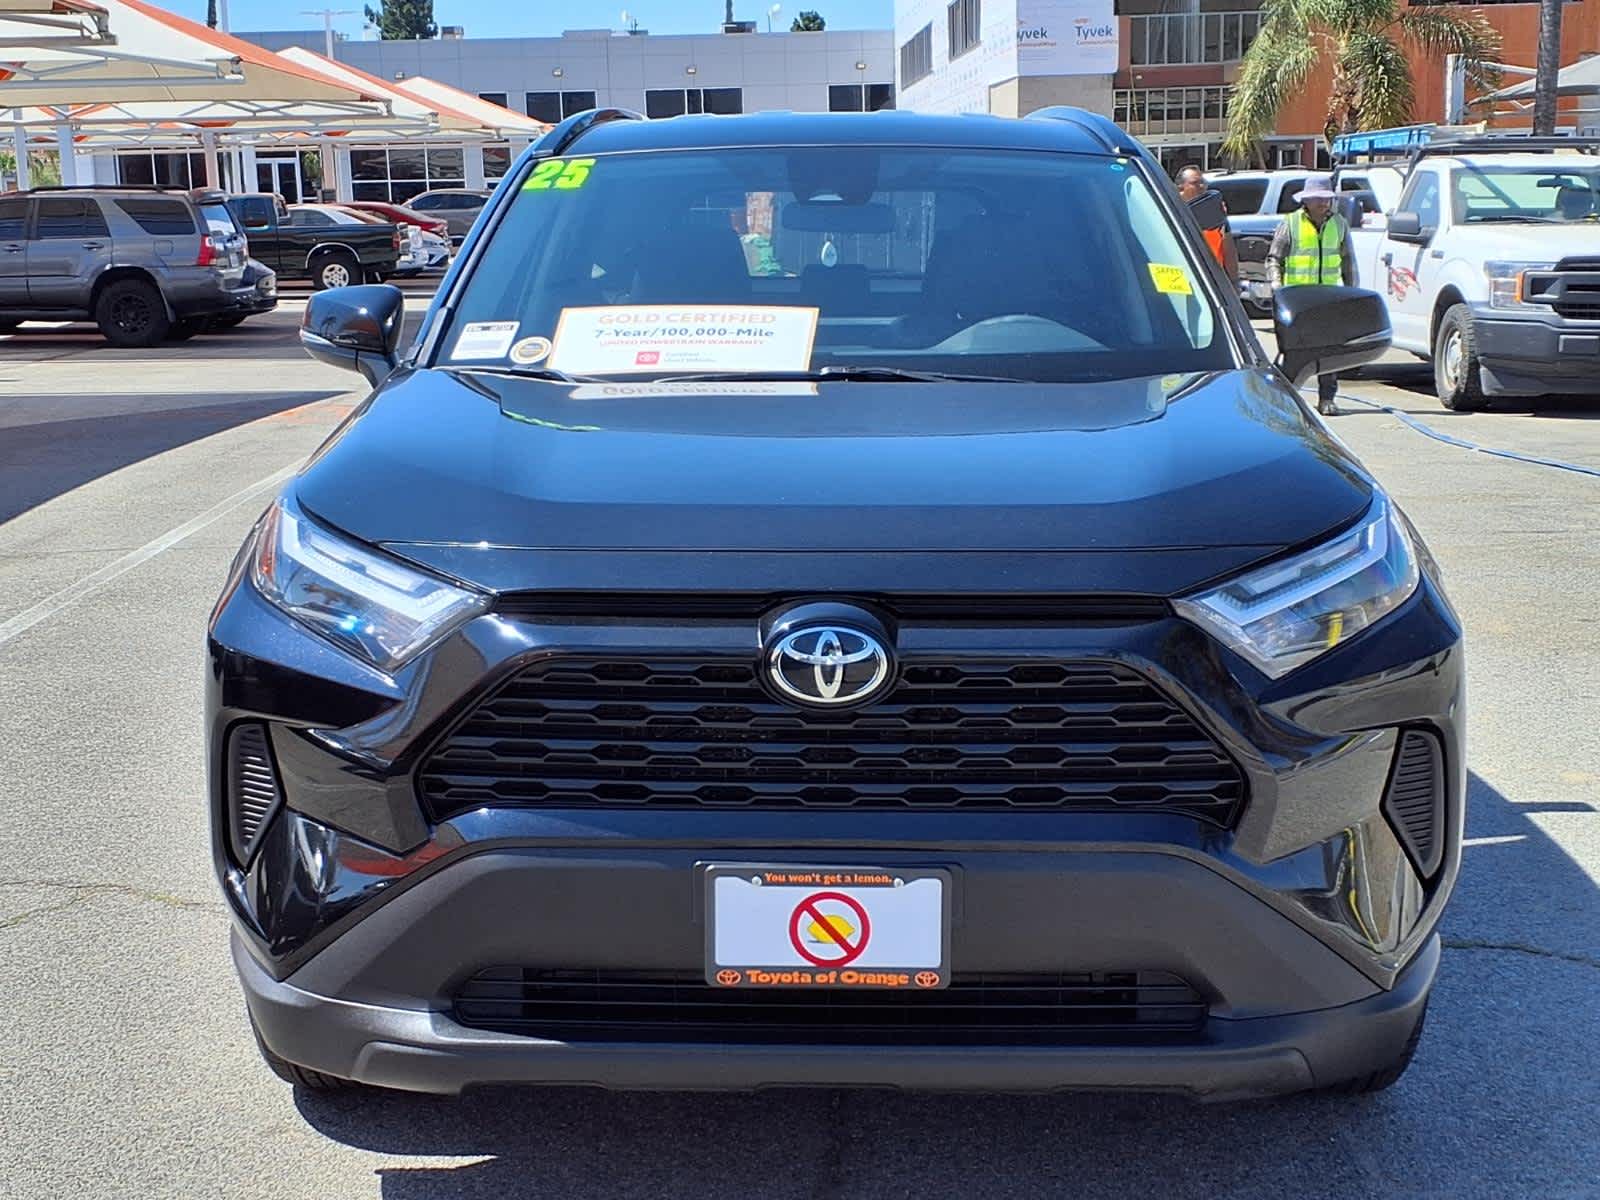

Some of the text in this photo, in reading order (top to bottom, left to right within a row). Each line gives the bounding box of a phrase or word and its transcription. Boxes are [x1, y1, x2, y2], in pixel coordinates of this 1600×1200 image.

[1074, 25, 1112, 40] Tyvek
[521, 158, 597, 191] 25
[598, 311, 777, 324] GOLD CERTIFIED
[595, 327, 775, 338] 7-Year/100,000-Mile
[765, 872, 892, 885] You won't get a lemon.
[746, 970, 909, 986] Toyota of Orange
